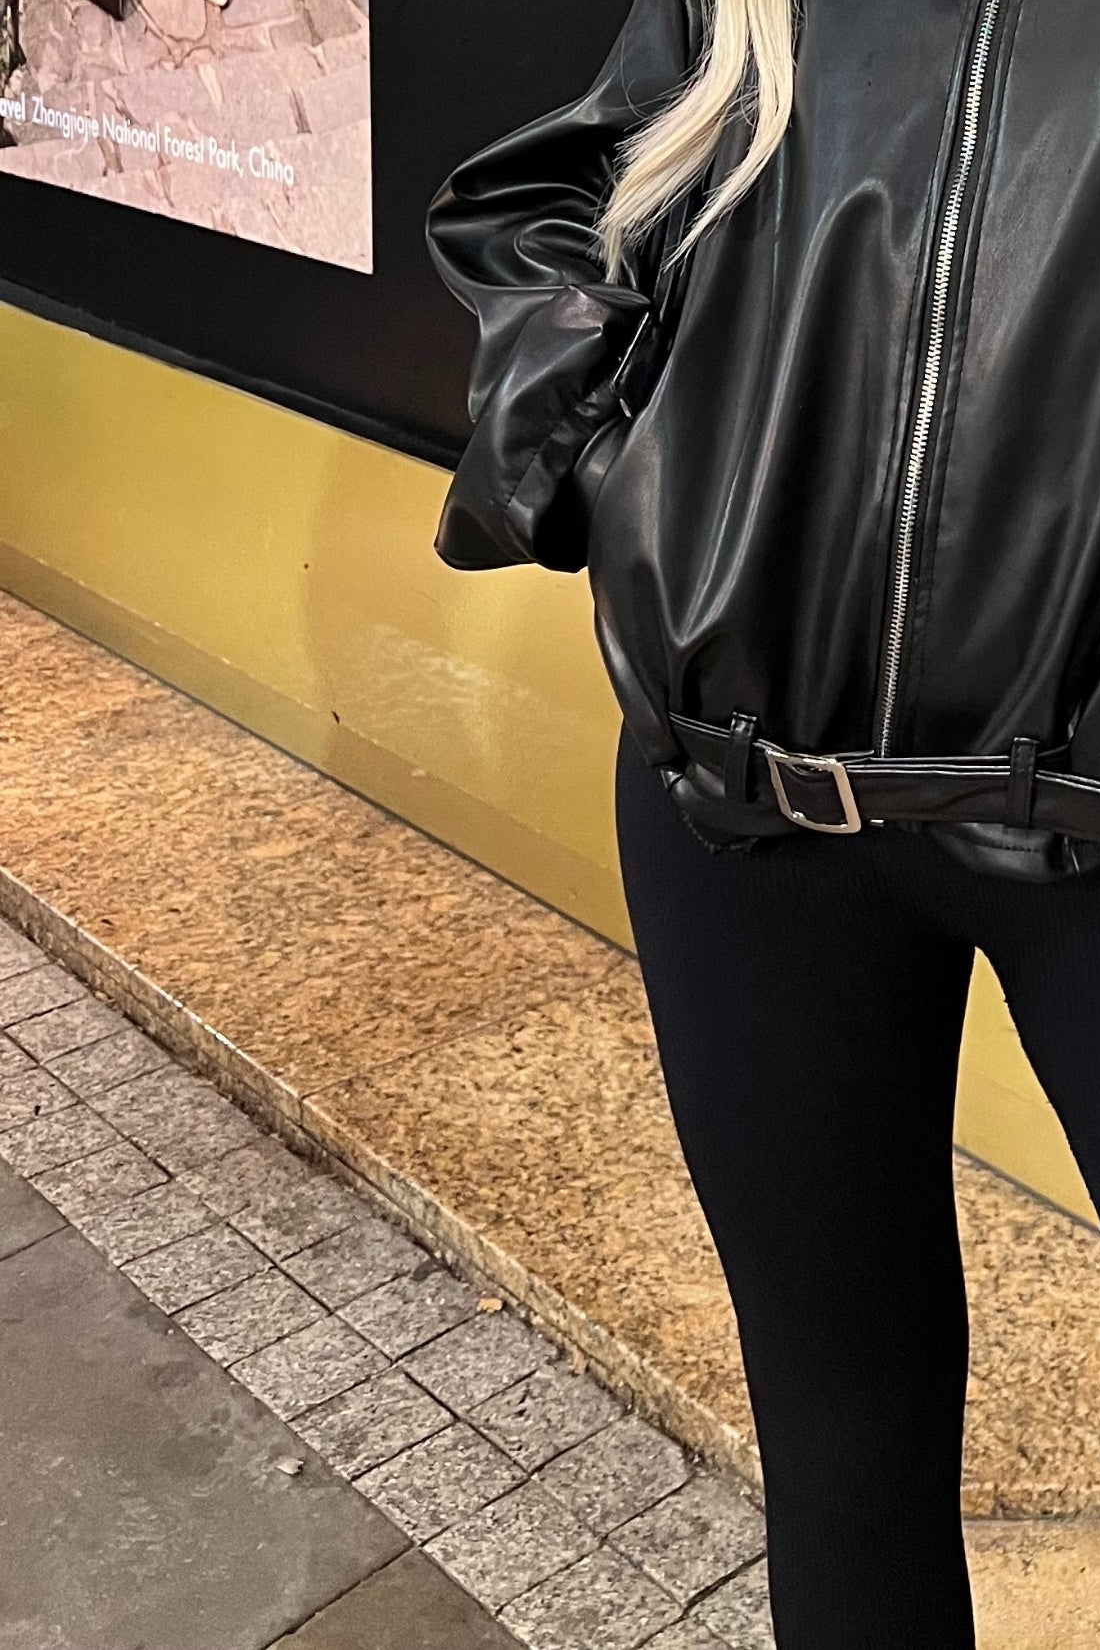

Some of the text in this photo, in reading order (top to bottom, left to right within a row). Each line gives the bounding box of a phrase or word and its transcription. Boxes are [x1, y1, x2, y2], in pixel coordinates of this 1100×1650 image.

[32, 95, 99, 143] Zhangjiajie
[102, 113, 161, 152] National
[164, 126, 206, 163] Forest
[208, 138, 244, 178] Park,
[248, 146, 295, 186] China
